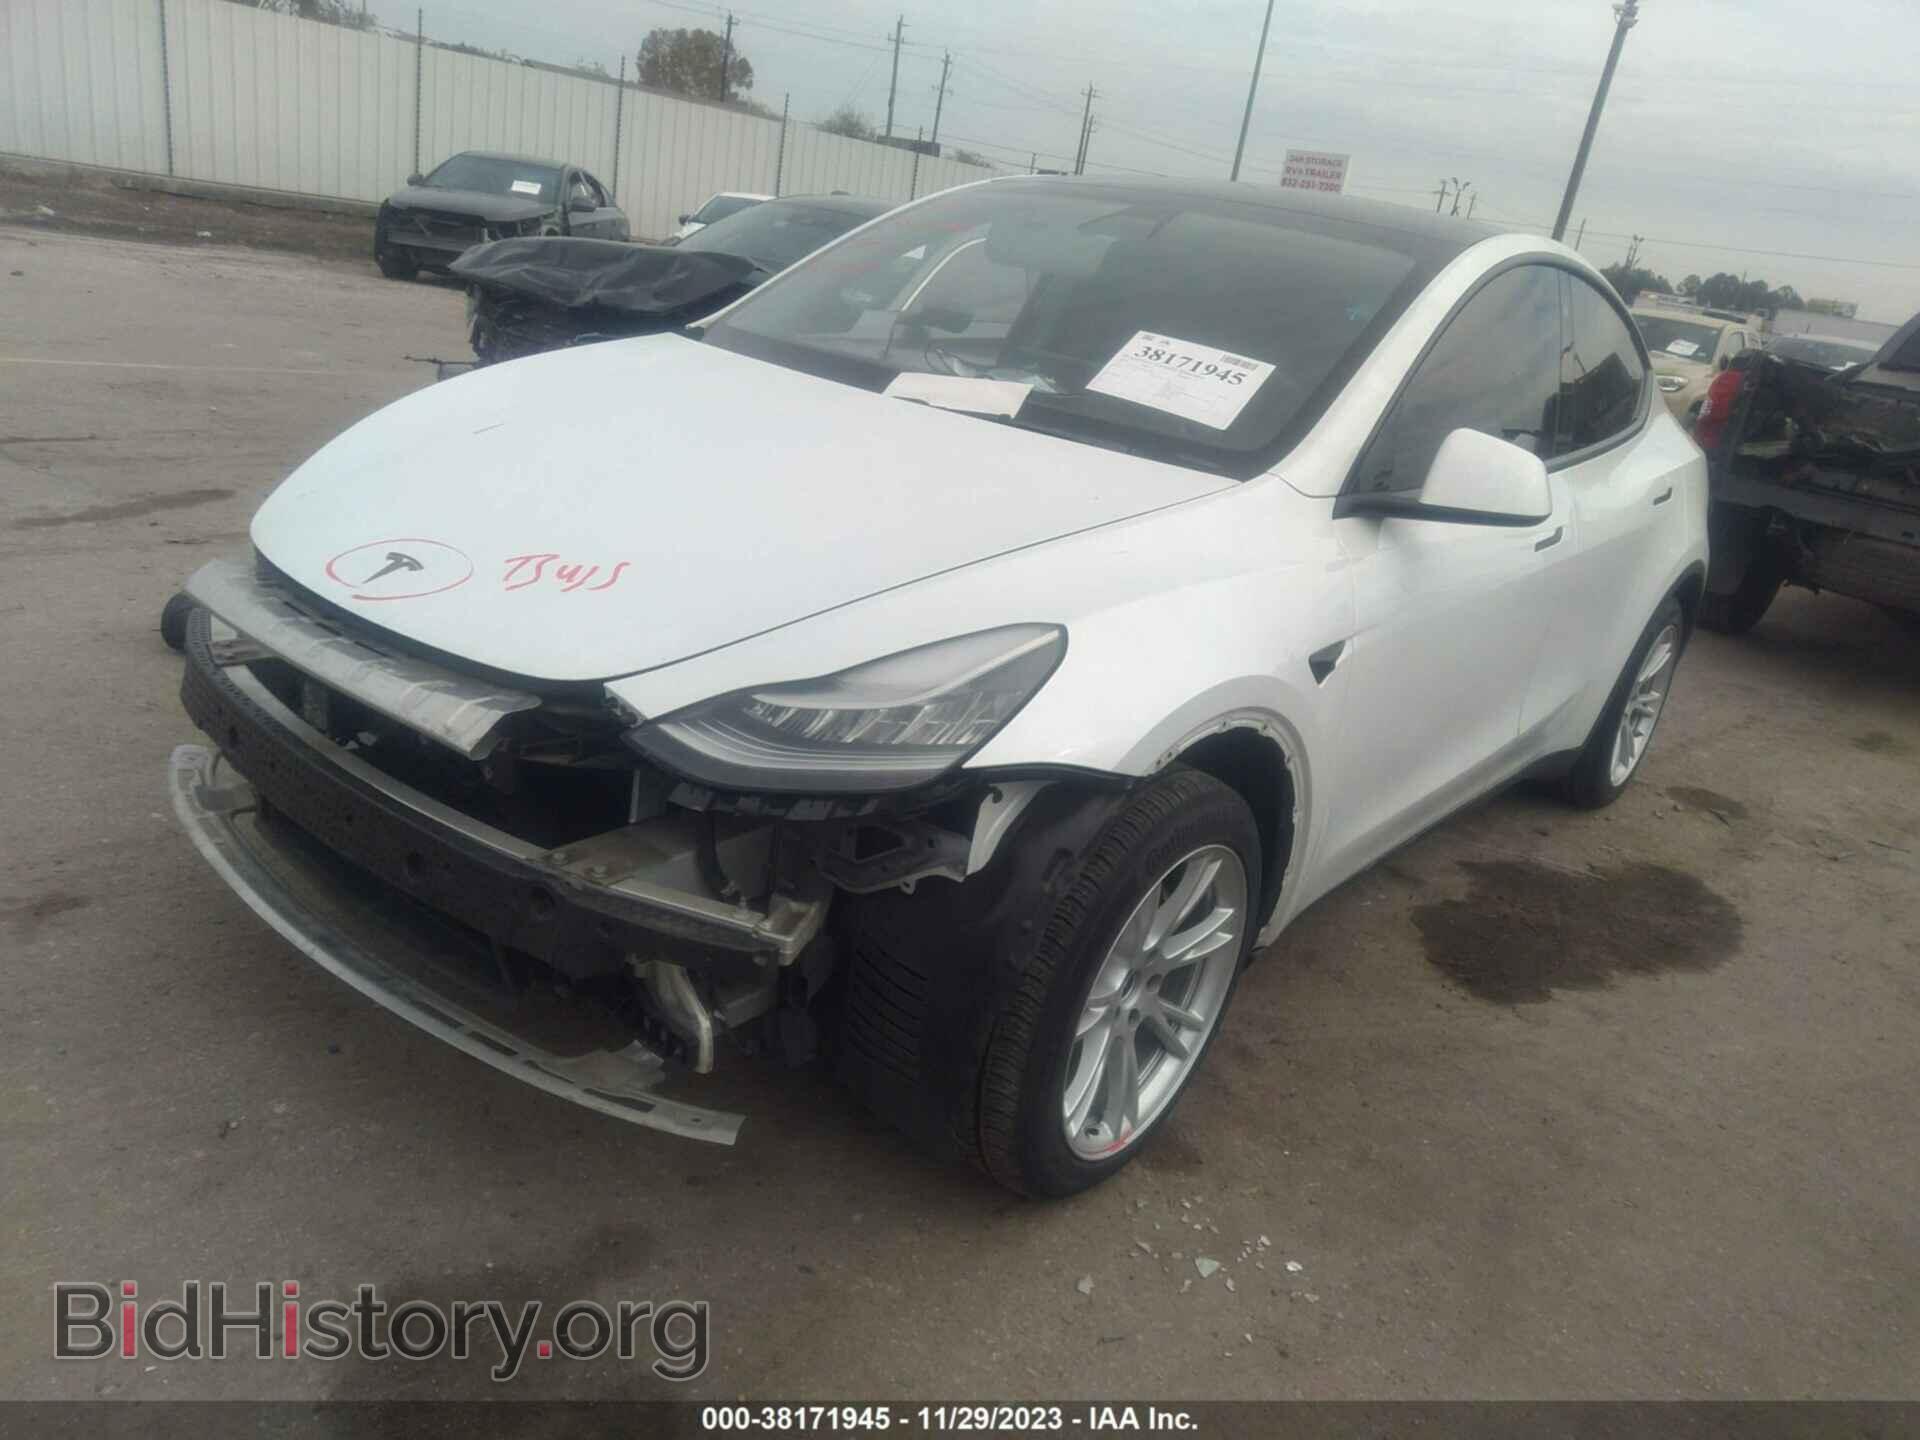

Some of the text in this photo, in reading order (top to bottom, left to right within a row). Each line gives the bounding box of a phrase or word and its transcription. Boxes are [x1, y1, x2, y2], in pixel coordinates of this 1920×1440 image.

[1305, 156, 1343, 167] STORAGE
[1304, 168, 1342, 179] TRAILER
[1133, 346, 1247, 385] 38171945
